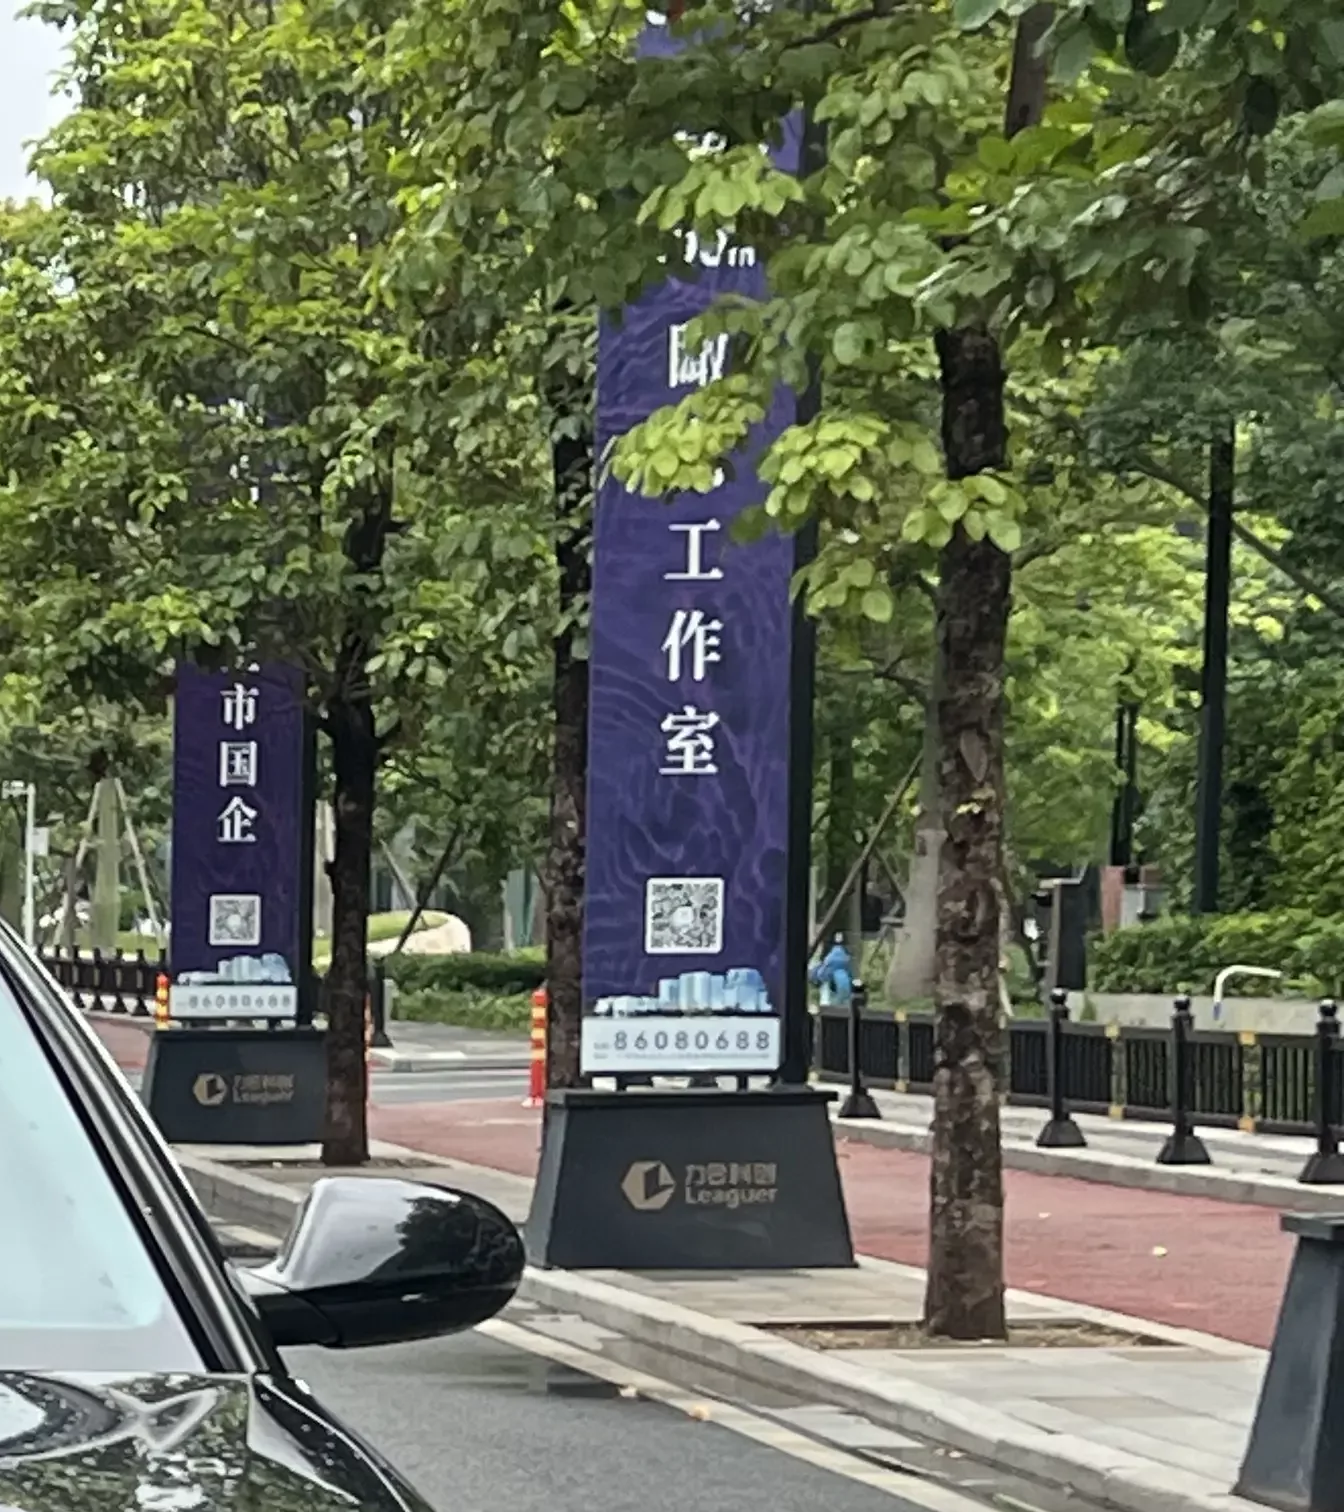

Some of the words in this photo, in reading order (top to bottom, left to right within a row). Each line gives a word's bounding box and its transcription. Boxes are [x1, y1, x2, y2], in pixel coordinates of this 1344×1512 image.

[659, 324, 729, 775] 工作室
[216, 663, 261, 843] 市国企
[614, 1030, 770, 1050] 86080688
[685, 1187, 779, 1208] Leaguer
